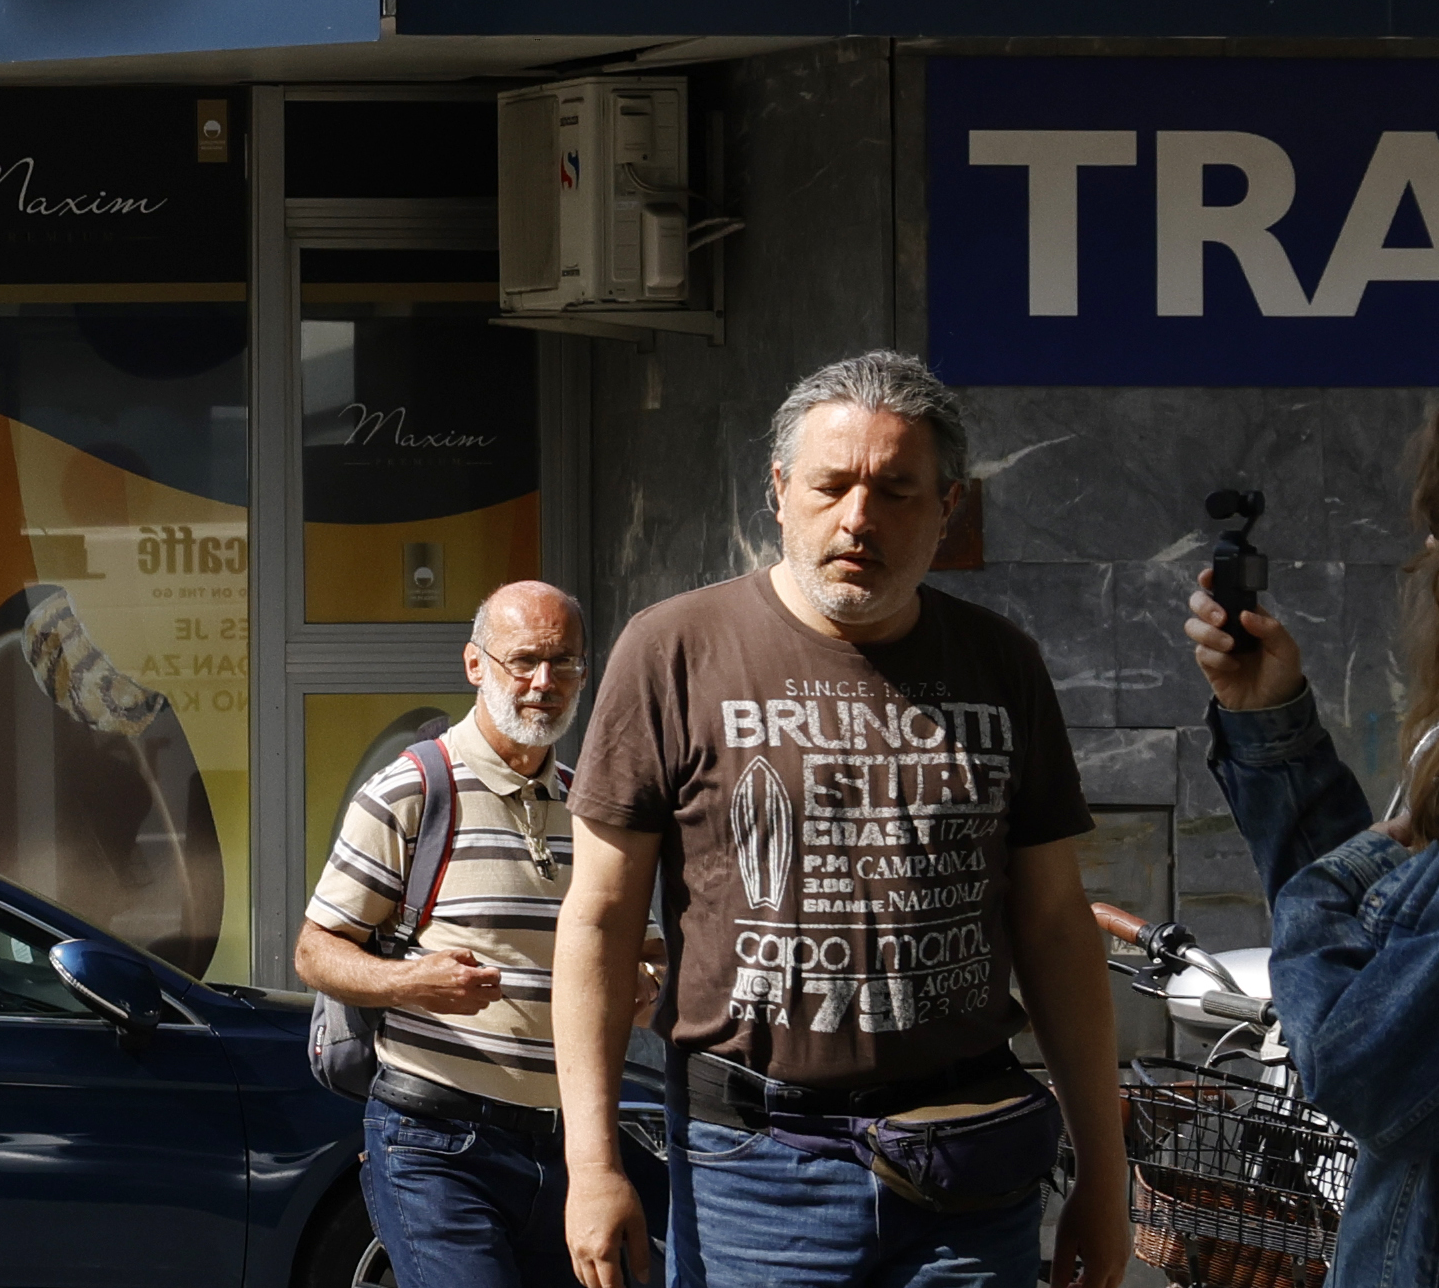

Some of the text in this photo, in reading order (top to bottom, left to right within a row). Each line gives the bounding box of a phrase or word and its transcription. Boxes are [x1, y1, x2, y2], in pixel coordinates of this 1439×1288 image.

[969, 130, 1439, 318] TRA
[338, 403, 497, 447] Maxim
[722, 700, 1013, 751] BRUNOTTI
[803, 753, 1010, 815] SURF
[803, 820, 930, 846] COAST
[803, 898, 884, 913] GRANDE
[737, 931, 850, 989] capo
[729, 1000, 790, 1029] DATA
[802, 980, 915, 1033] 79
